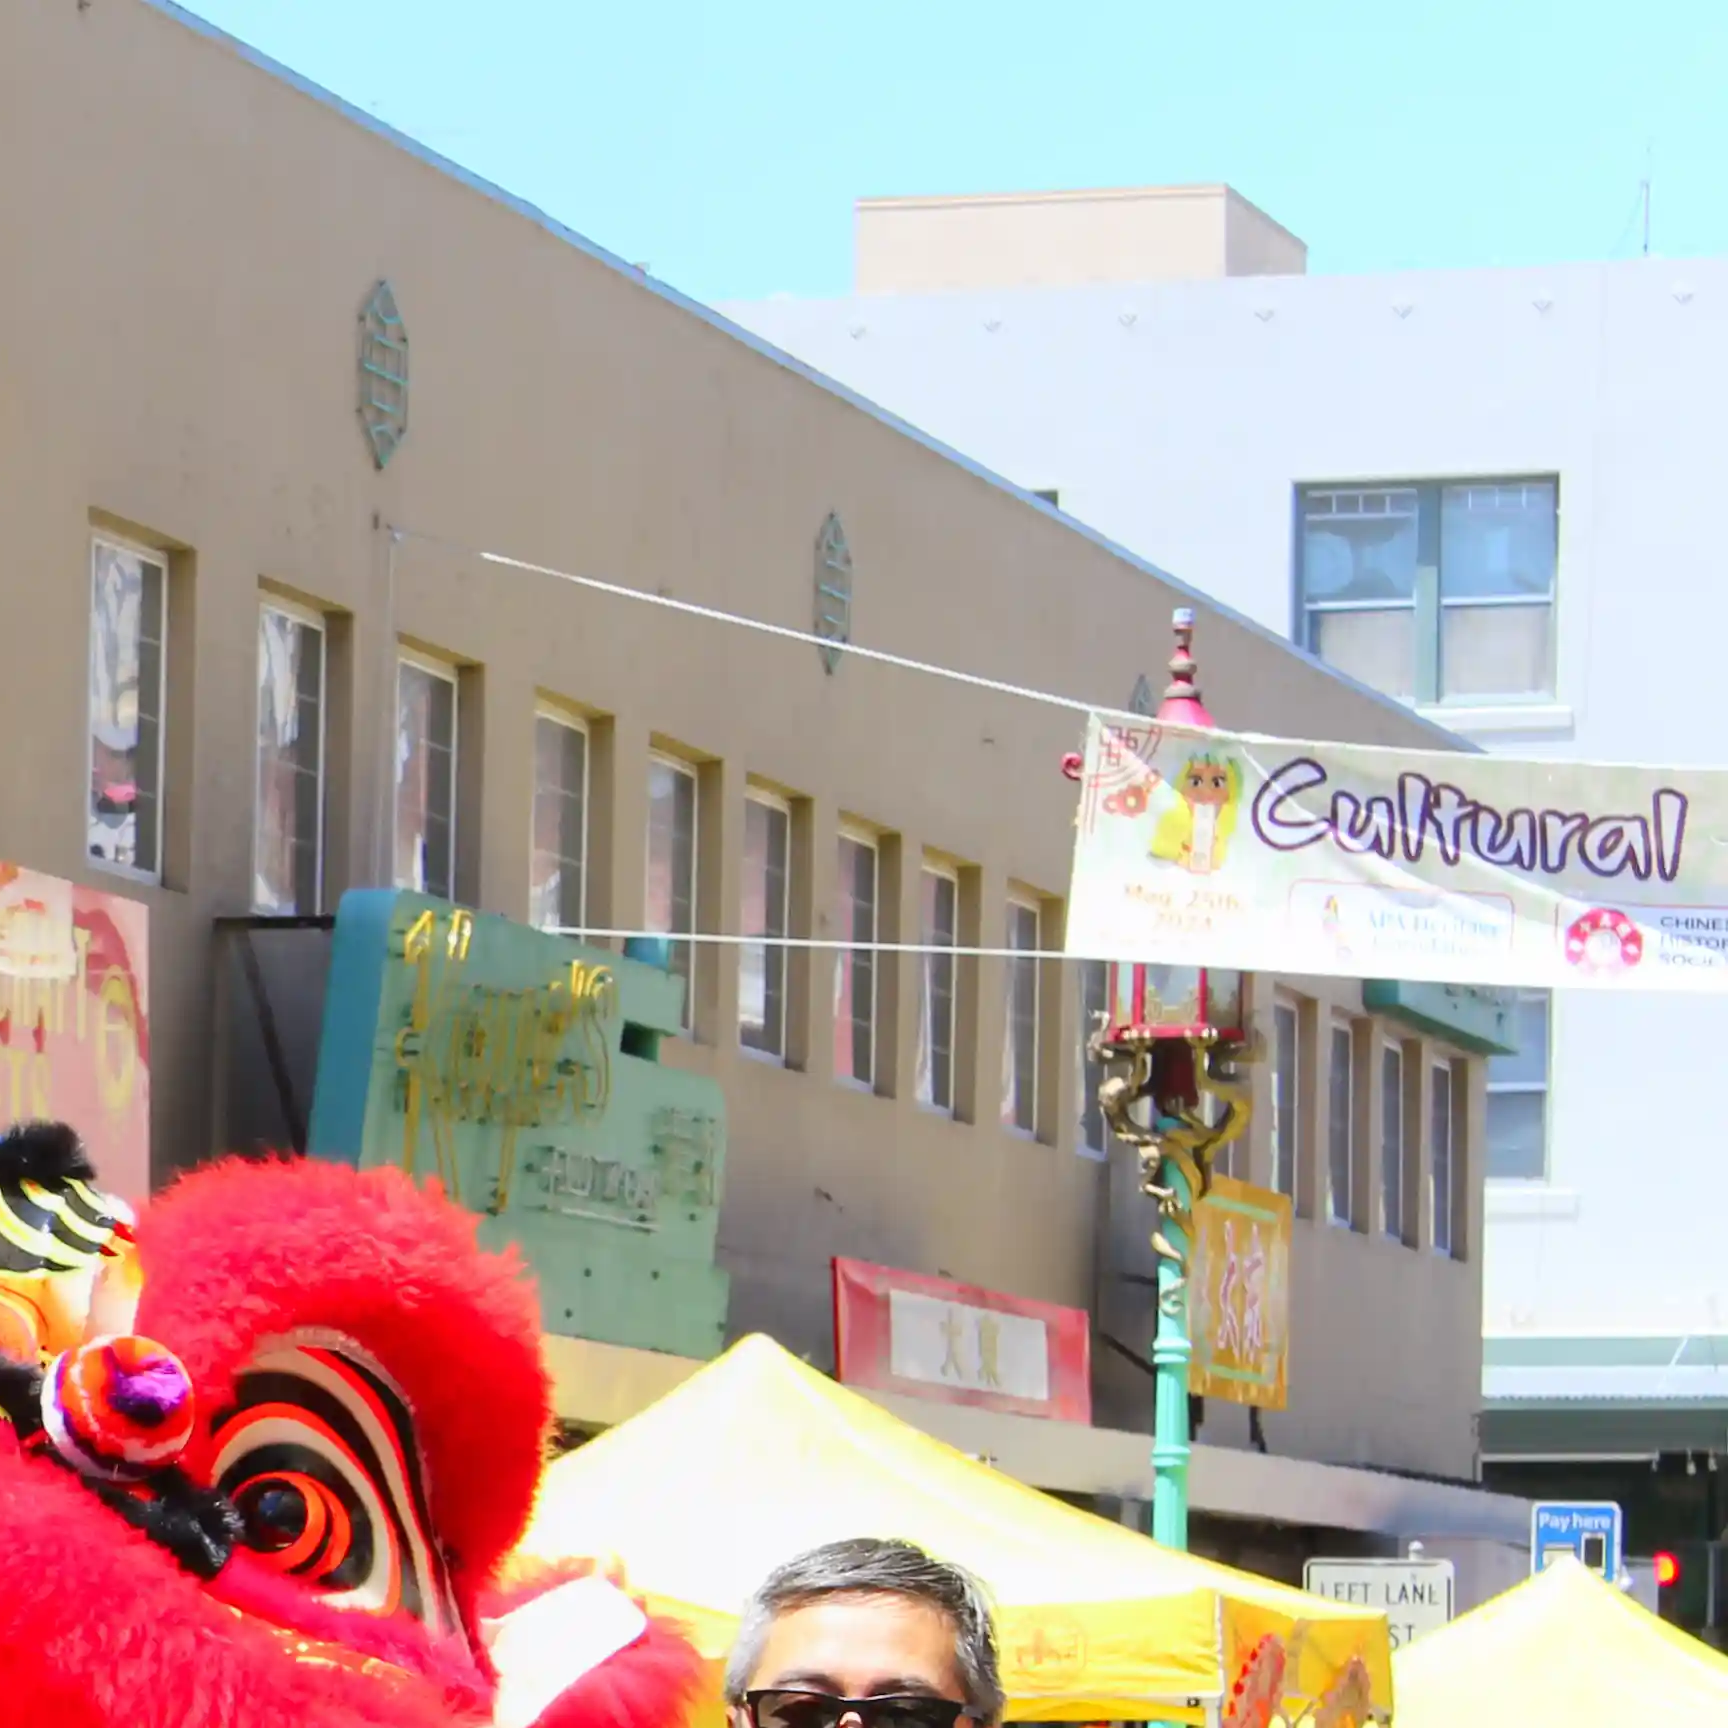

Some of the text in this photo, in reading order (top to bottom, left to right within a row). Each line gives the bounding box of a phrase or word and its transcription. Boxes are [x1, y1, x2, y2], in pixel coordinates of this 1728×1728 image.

[1251, 757, 1689, 882] Cultural
[1659, 915, 1728, 932] CHINE
[1538, 1511, 1611, 1534] Pay here
[1319, 1580, 1440, 1606] LEFT LANE
